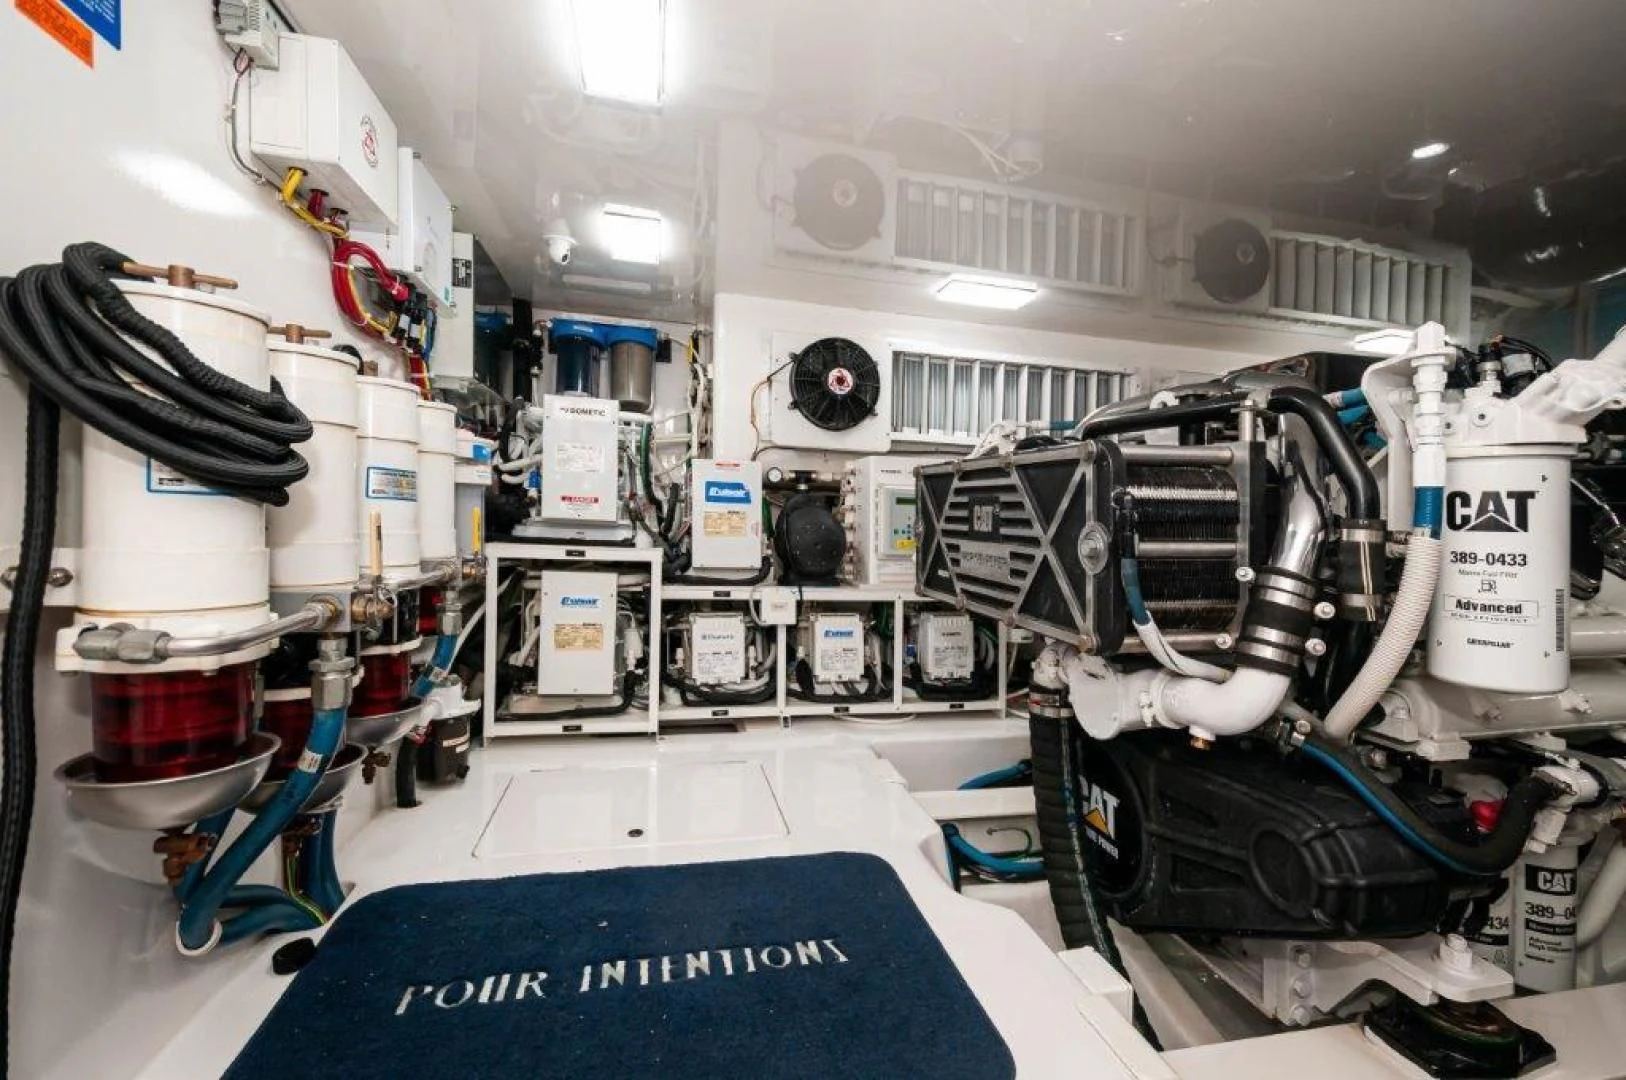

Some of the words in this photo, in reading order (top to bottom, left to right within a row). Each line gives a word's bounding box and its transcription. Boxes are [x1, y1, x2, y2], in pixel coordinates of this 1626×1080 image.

[1446, 490, 1536, 533] CAT
[1450, 550, 1527, 567] 389-0433
[1456, 599, 1522, 614] Advanced
[1537, 871, 1574, 892] CAT
[394, 971, 549, 1016] POUR
[579, 938, 849, 993] INTENTIONS
